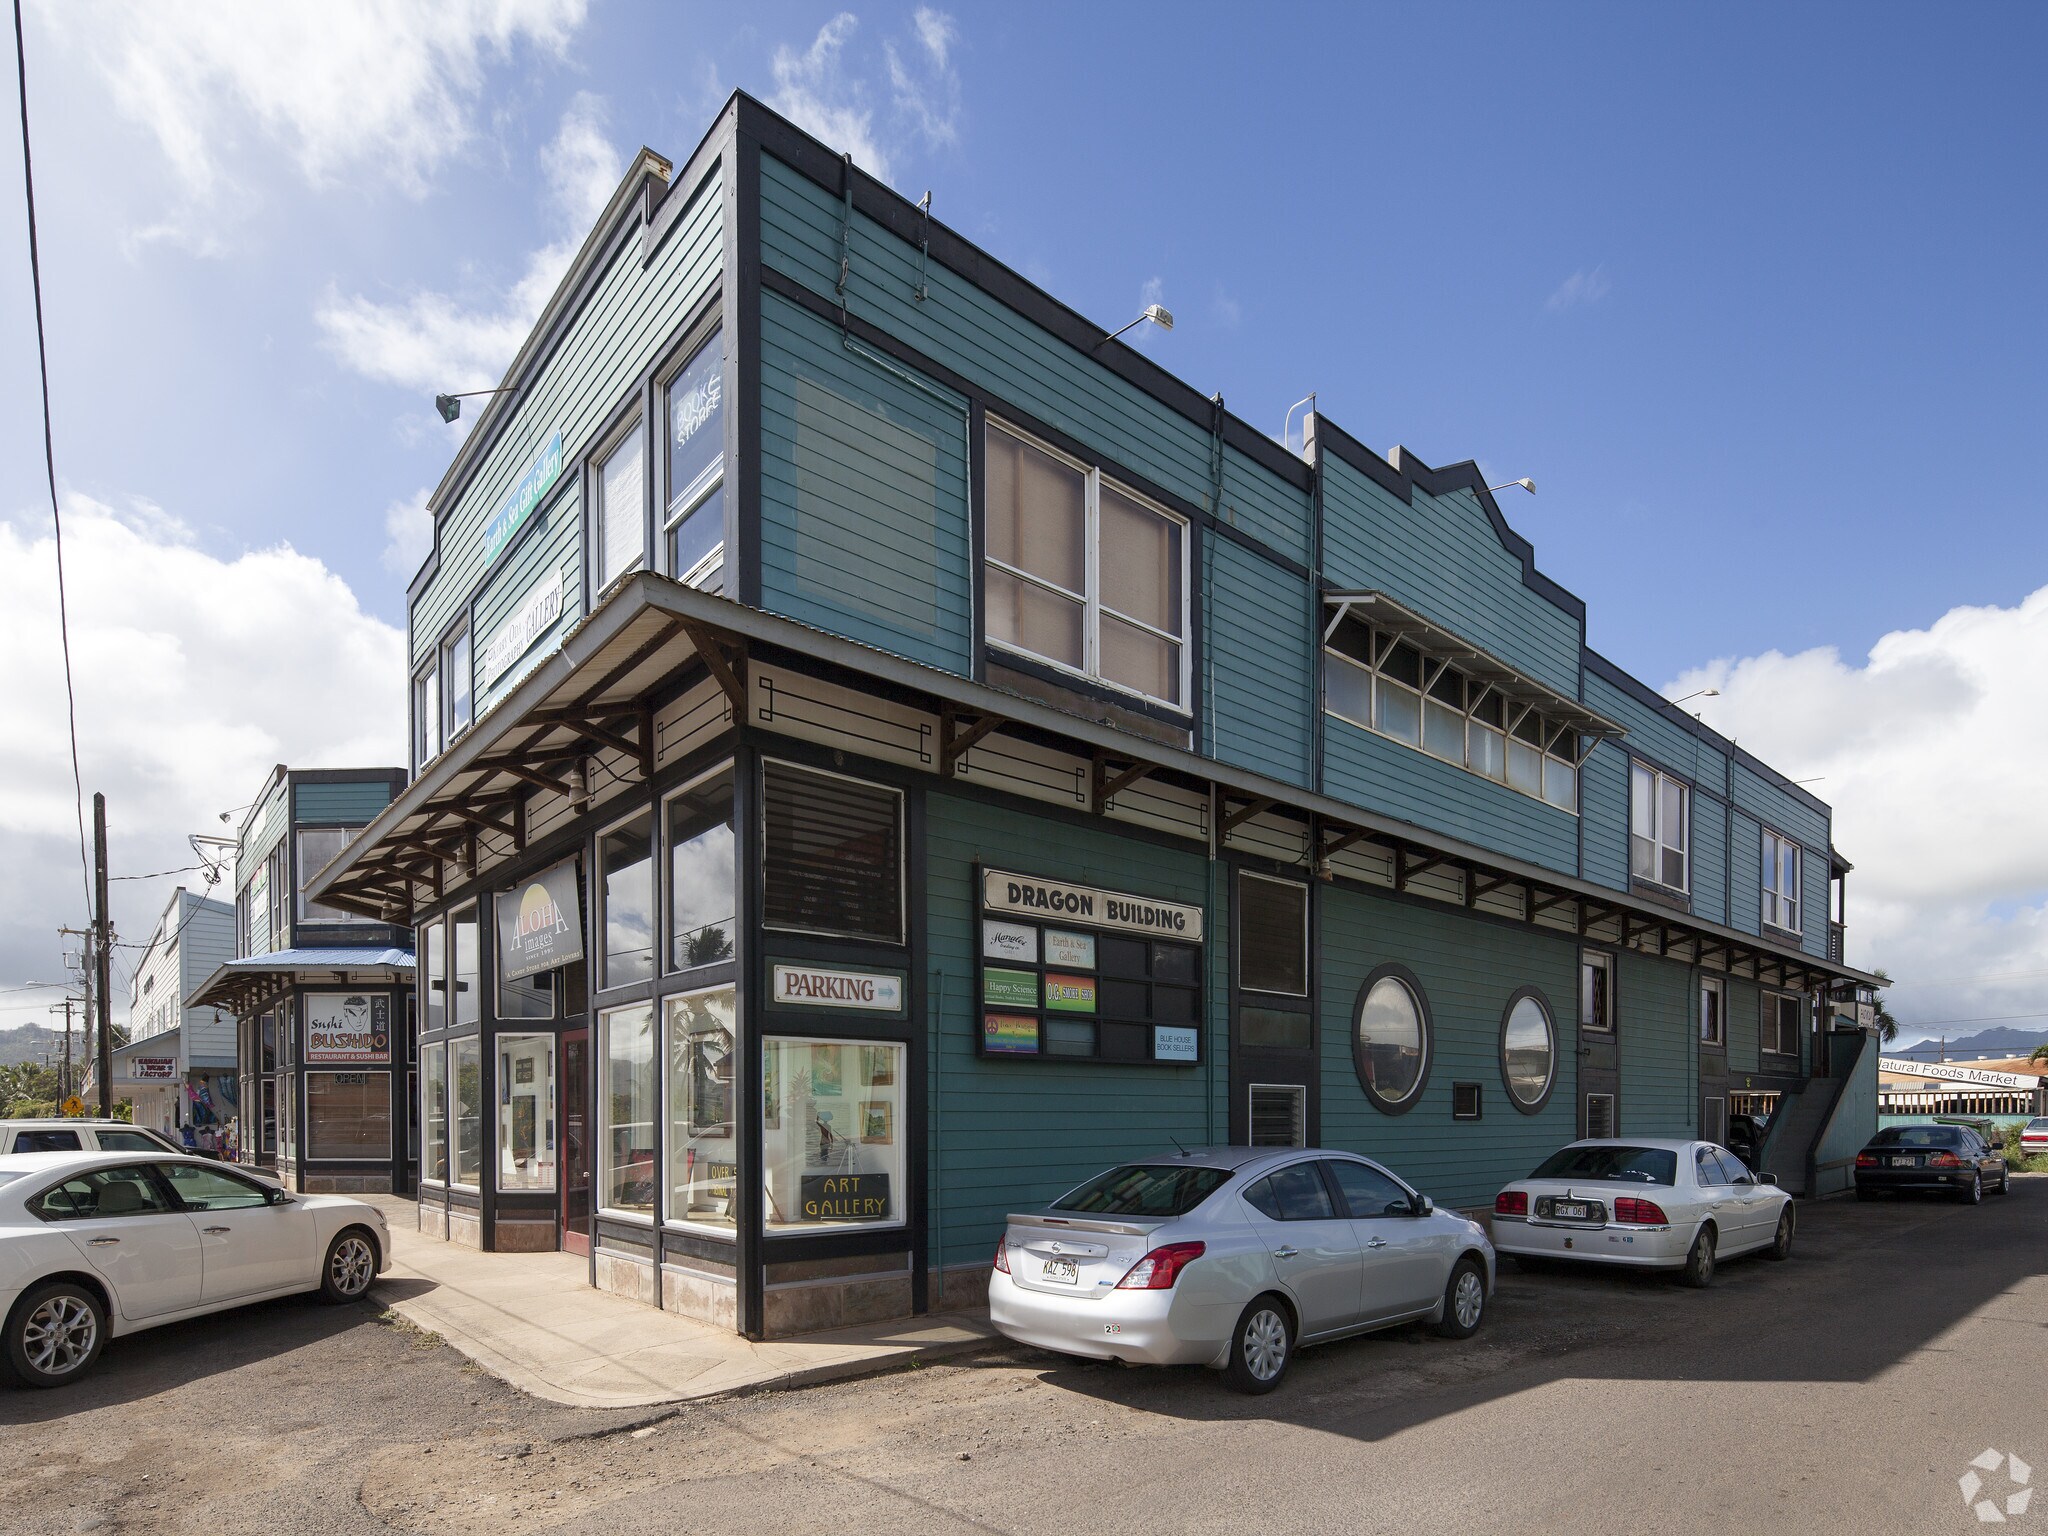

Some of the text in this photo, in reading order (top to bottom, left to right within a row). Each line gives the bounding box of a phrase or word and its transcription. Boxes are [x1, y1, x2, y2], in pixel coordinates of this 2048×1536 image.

[486, 449, 559, 558] Earth & Sea Gift Gallery
[526, 584, 561, 643] GALLERY
[1008, 882, 1186, 931] DRAGON BUILDING
[510, 899, 570, 951] ALOHA
[525, 931, 553, 951] images
[1053, 935, 1087, 950] Earth & Sea
[1059, 951, 1080, 963] Gallery
[785, 972, 874, 1001] PARKING
[989, 982, 1037, 995] Happy Science
[1062, 986, 1079, 999] SMOKE
[1081, 988, 1093, 1000] SHOP
[374, 998, 386, 1031] 武士道
[311, 1016, 343, 1031] Sushi
[310, 1031, 387, 1049] BUSHIDO
[1160, 1034, 1192, 1044] BLUE HOUSE
[1157, 1043, 1194, 1052] BOOK SELLERS
[335, 1073, 364, 1084] OPEN
[1922, 1064, 1964, 1079] Foods
[1968, 1070, 2017, 1086] Market
[711, 1165, 730, 1180] OVER
[824, 1177, 860, 1193] ART
[805, 1198, 886, 1216] GALLERY
[1555, 1205, 1585, 1216] RGX 061
[1042, 1260, 1077, 1278] KAZ 598
[1105, 1325, 1111, 1333] 2
